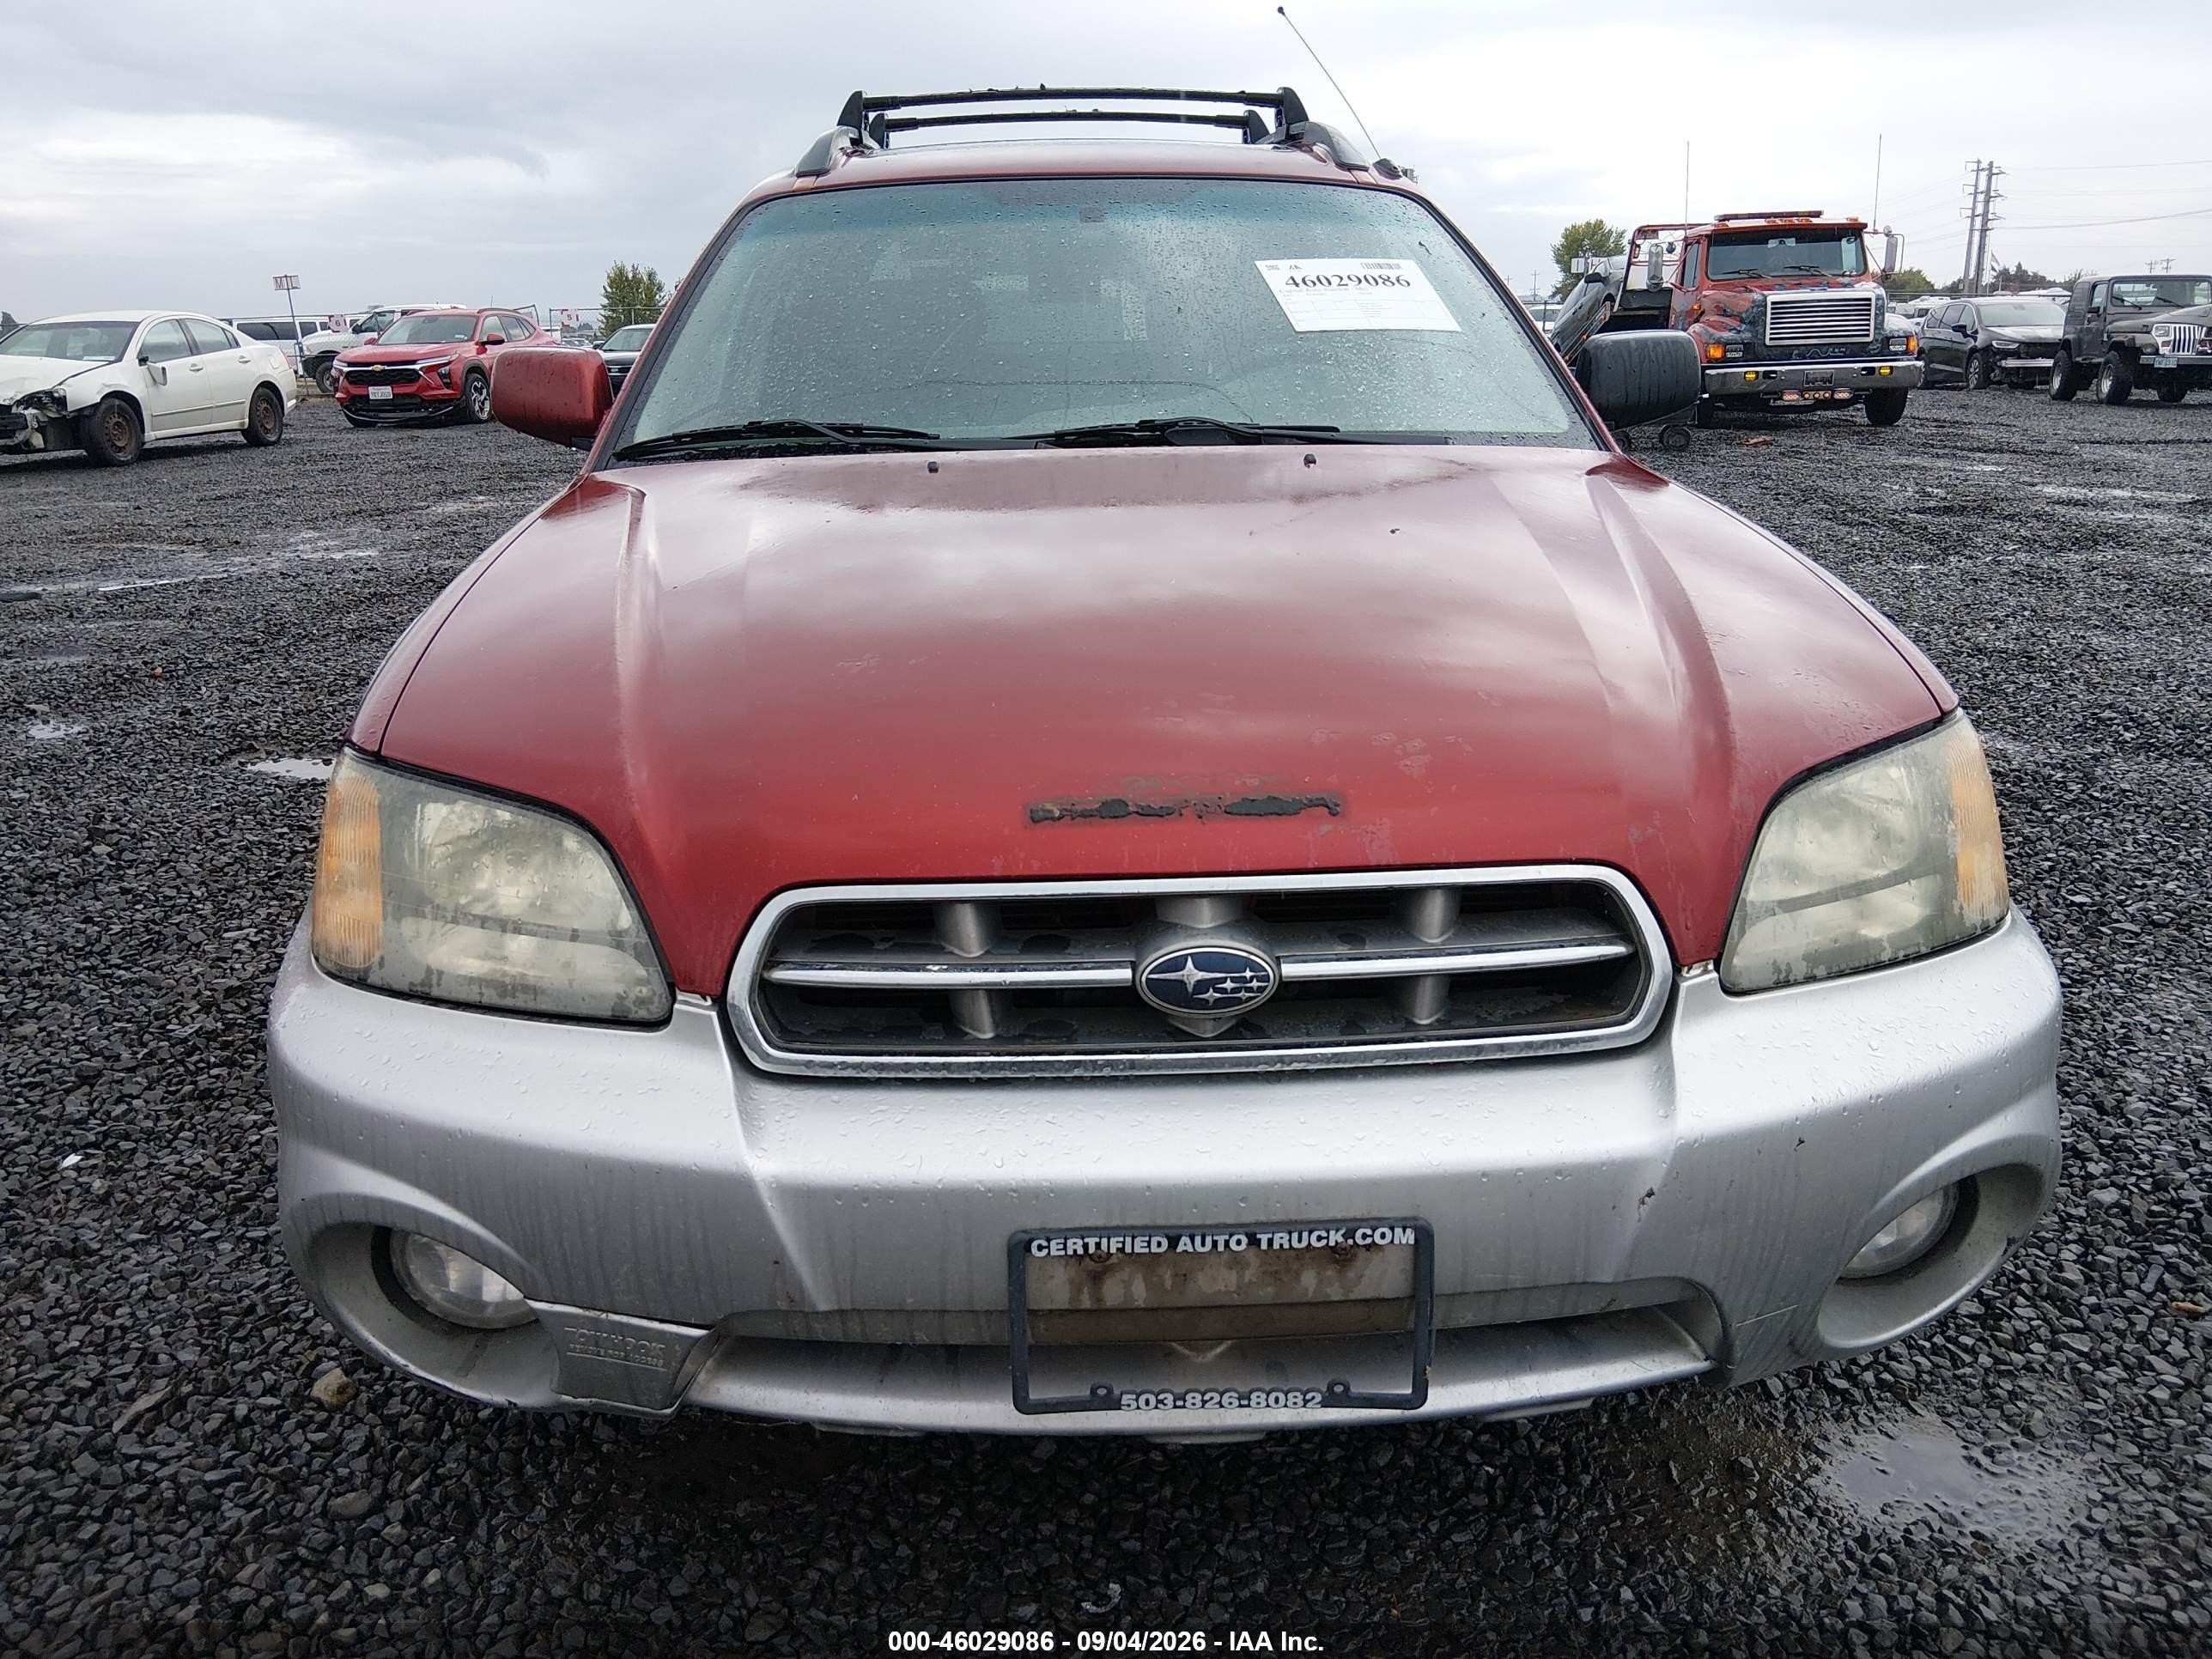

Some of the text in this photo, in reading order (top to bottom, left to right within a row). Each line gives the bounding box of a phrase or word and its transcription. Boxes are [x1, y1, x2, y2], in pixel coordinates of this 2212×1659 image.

[1285, 274, 1410, 288] 46029086
[1031, 1227, 1415, 1257] CERTIFIED AUTO TRUCK.COM
[1121, 1392, 1323, 1412] 503-826-8082
